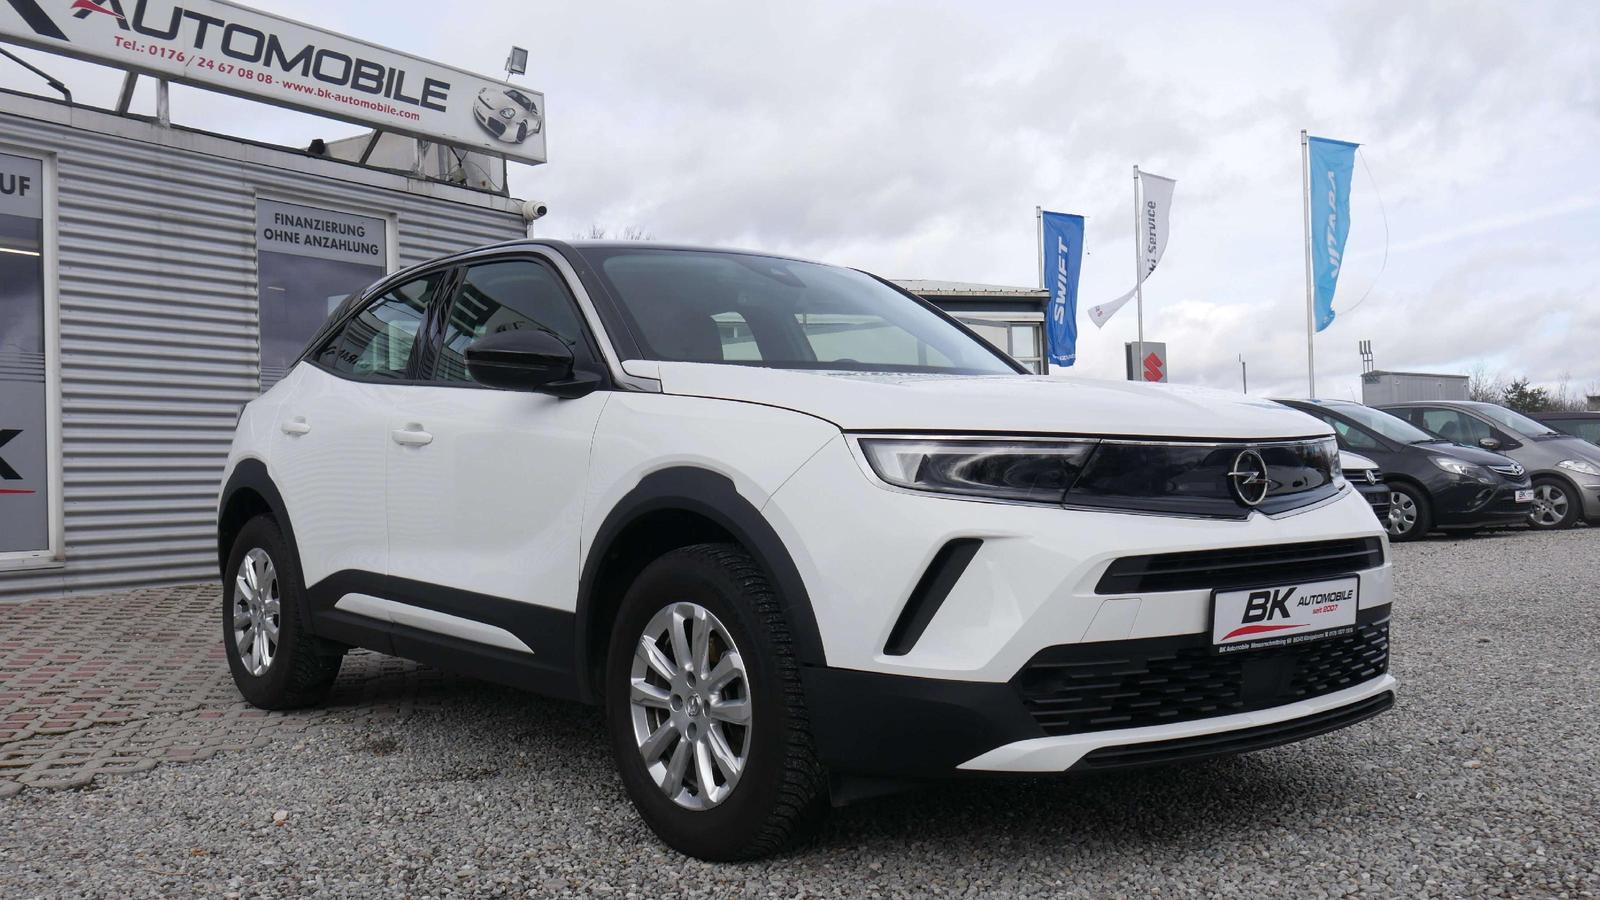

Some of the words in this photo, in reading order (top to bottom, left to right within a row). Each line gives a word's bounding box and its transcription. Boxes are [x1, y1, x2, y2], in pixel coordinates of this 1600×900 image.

[72, 0, 451, 113] AUTOMOBILE
[114, 35, 145, 53] Tel.:
[148, 45, 185, 62] 0176
[197, 57, 214, 69] 24
[218, 62, 235, 74] 67
[238, 67, 253, 80] 08
[256, 72, 272, 84] 08
[282, 79, 420, 121] www.bk-automobile.com
[263, 227, 300, 244] OHNE
[303, 234, 379, 256] ANZAHLUNG
[274, 212, 365, 238] FINANZIERUNG
[1147, 200, 1156, 254] Service
[1054, 236, 1069, 325] SWIFT
[1241, 586, 1297, 624] BK
[1297, 589, 1353, 607] AUTOMOBILE
[1323, 604, 1339, 614] 2007
